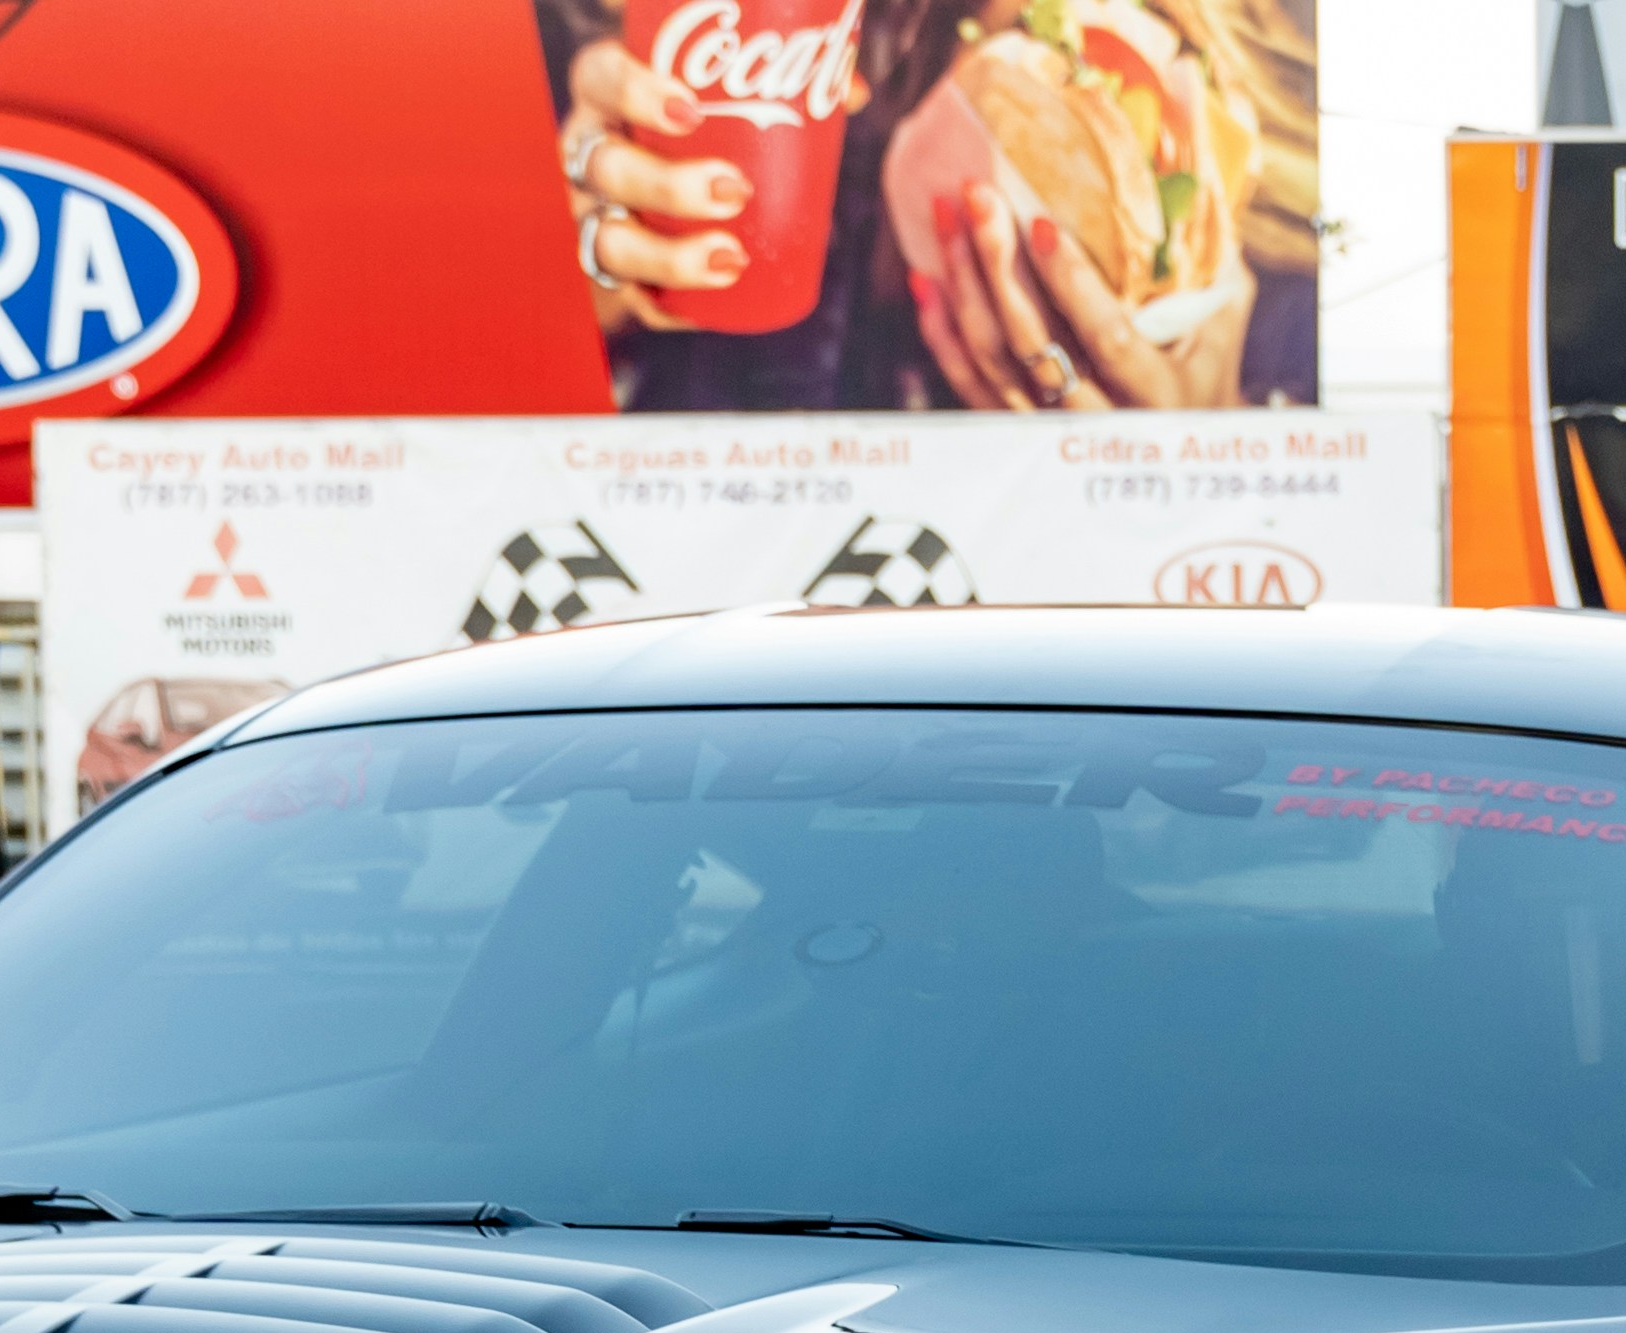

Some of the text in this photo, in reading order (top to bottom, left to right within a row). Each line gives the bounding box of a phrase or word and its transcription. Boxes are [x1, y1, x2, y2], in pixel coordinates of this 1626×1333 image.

[87, 442, 406, 480] Cayey Auto Mall
[565, 439, 911, 476] Caguas Auto Mall
[1059, 431, 1367, 464] Cidra Auto Mall
[124, 482, 207, 514] (787)
[601, 480, 686, 510] (787)
[1085, 473, 1171, 507] (787)
[1184, 562, 1292, 604] KIA
[164, 613, 293, 630] MITSUBISHI
[182, 638, 274, 656] MOTORS
[1287, 764, 1618, 809] BY PACHECO
